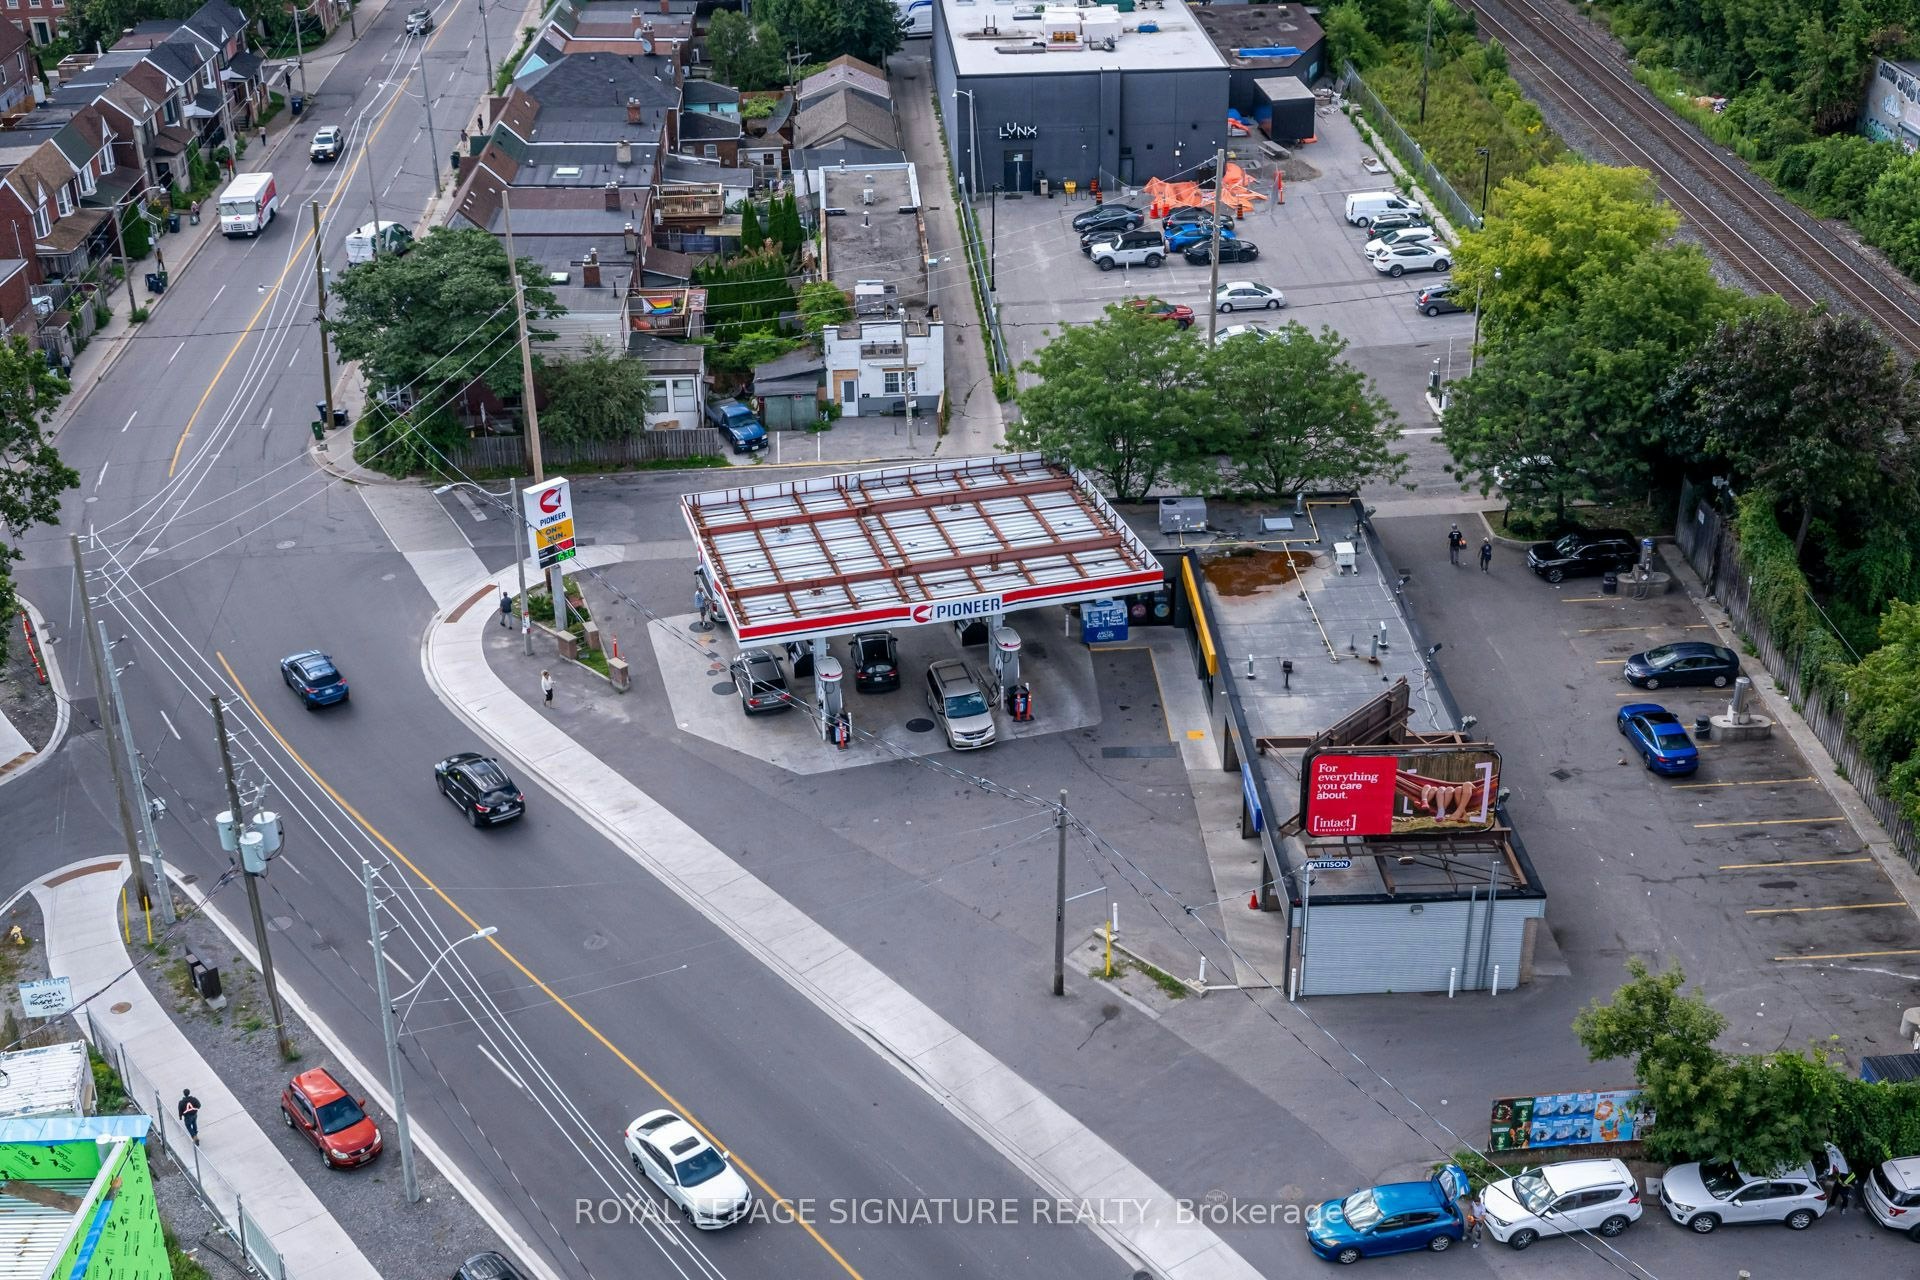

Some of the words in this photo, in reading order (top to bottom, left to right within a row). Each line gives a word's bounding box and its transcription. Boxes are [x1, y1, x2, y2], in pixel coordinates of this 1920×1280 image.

[999, 122, 1037, 136] LYNX
[540, 511, 566, 526] PIONEER
[937, 598, 1000, 618] PIONEER
[1319, 763, 1338, 773] For
[1318, 772, 1379, 784] everything
[1317, 783, 1338, 793] you
[1340, 782, 1362, 790] care
[1316, 791, 1348, 800] about.
